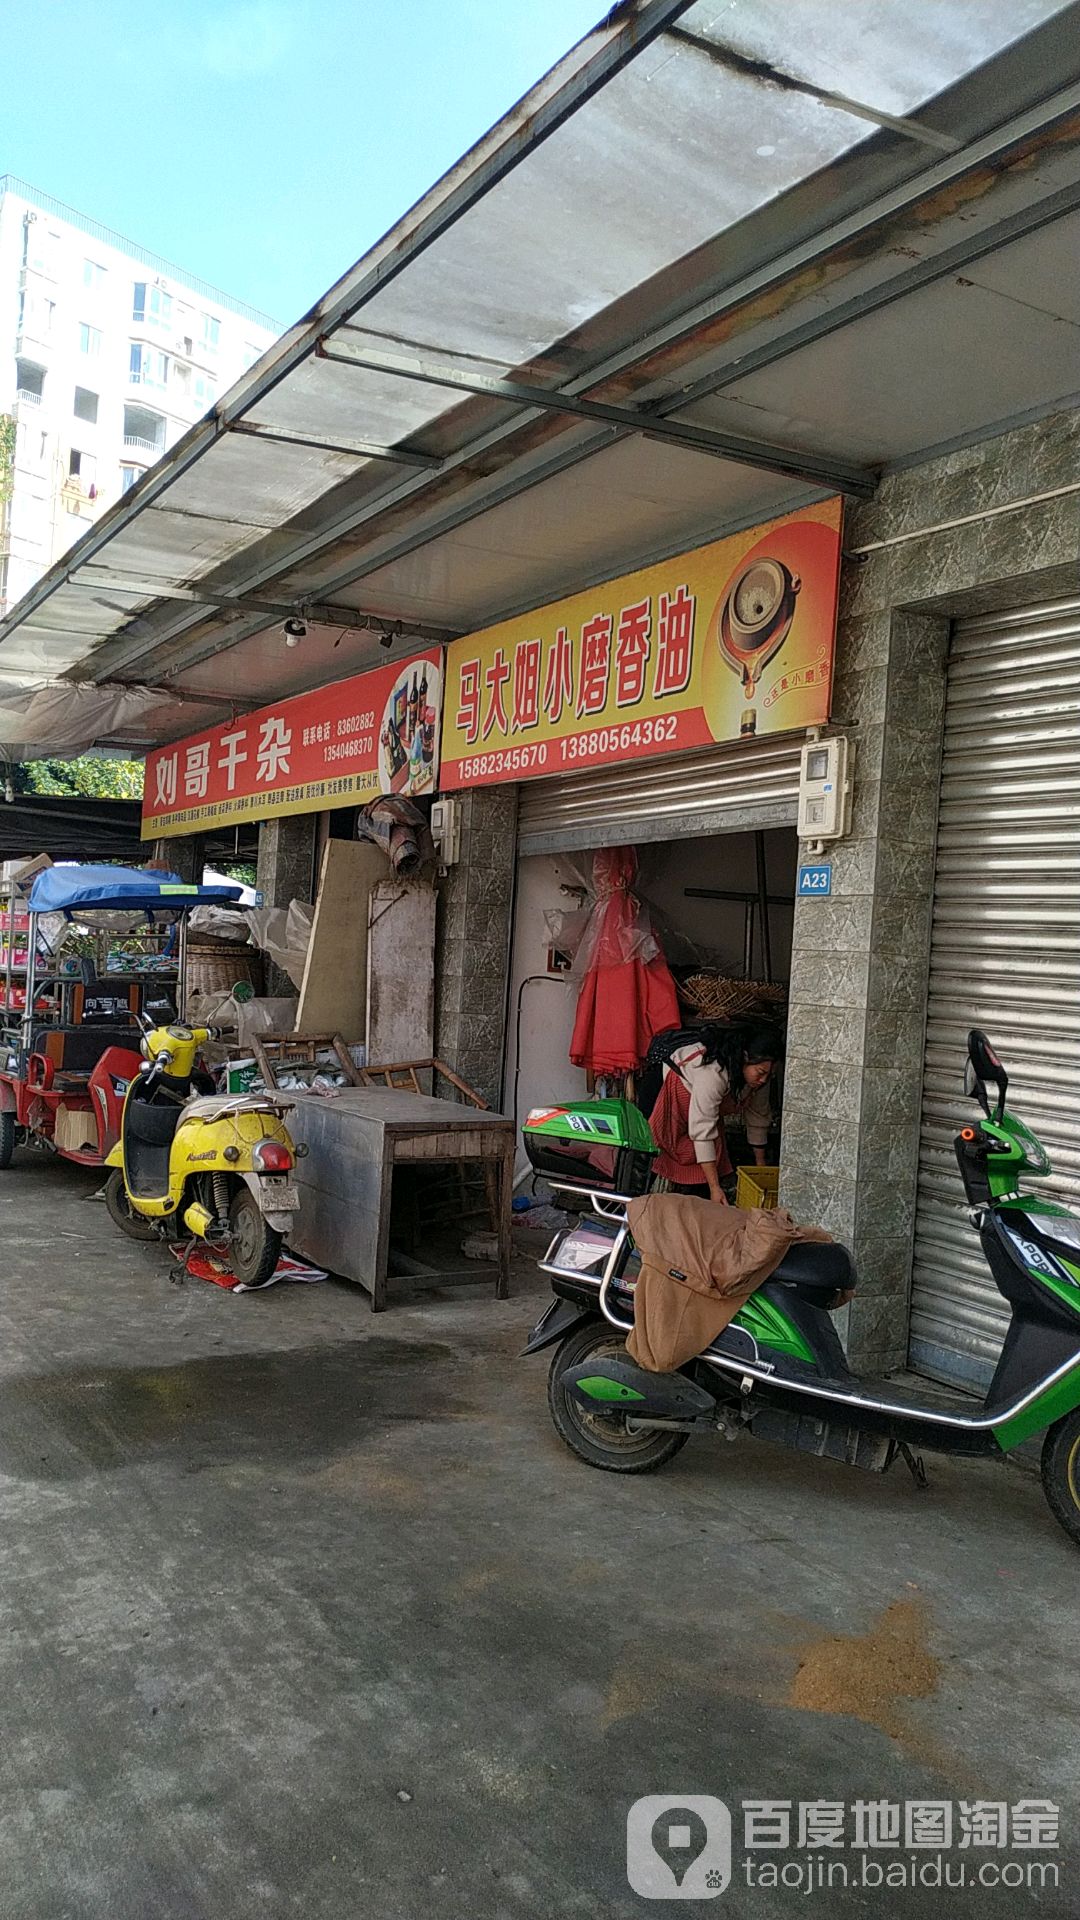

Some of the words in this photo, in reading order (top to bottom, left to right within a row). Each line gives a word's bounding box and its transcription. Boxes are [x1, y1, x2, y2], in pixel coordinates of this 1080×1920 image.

[456, 584, 697, 746] 马大姐小磨香油
[153, 717, 292, 808] 刘哥干杂
[323, 735, 373, 762] 13540468370
[458, 745, 548, 780] 15882345670
[560, 715, 678, 761] 13880564362
[801, 873, 828, 889] A23
